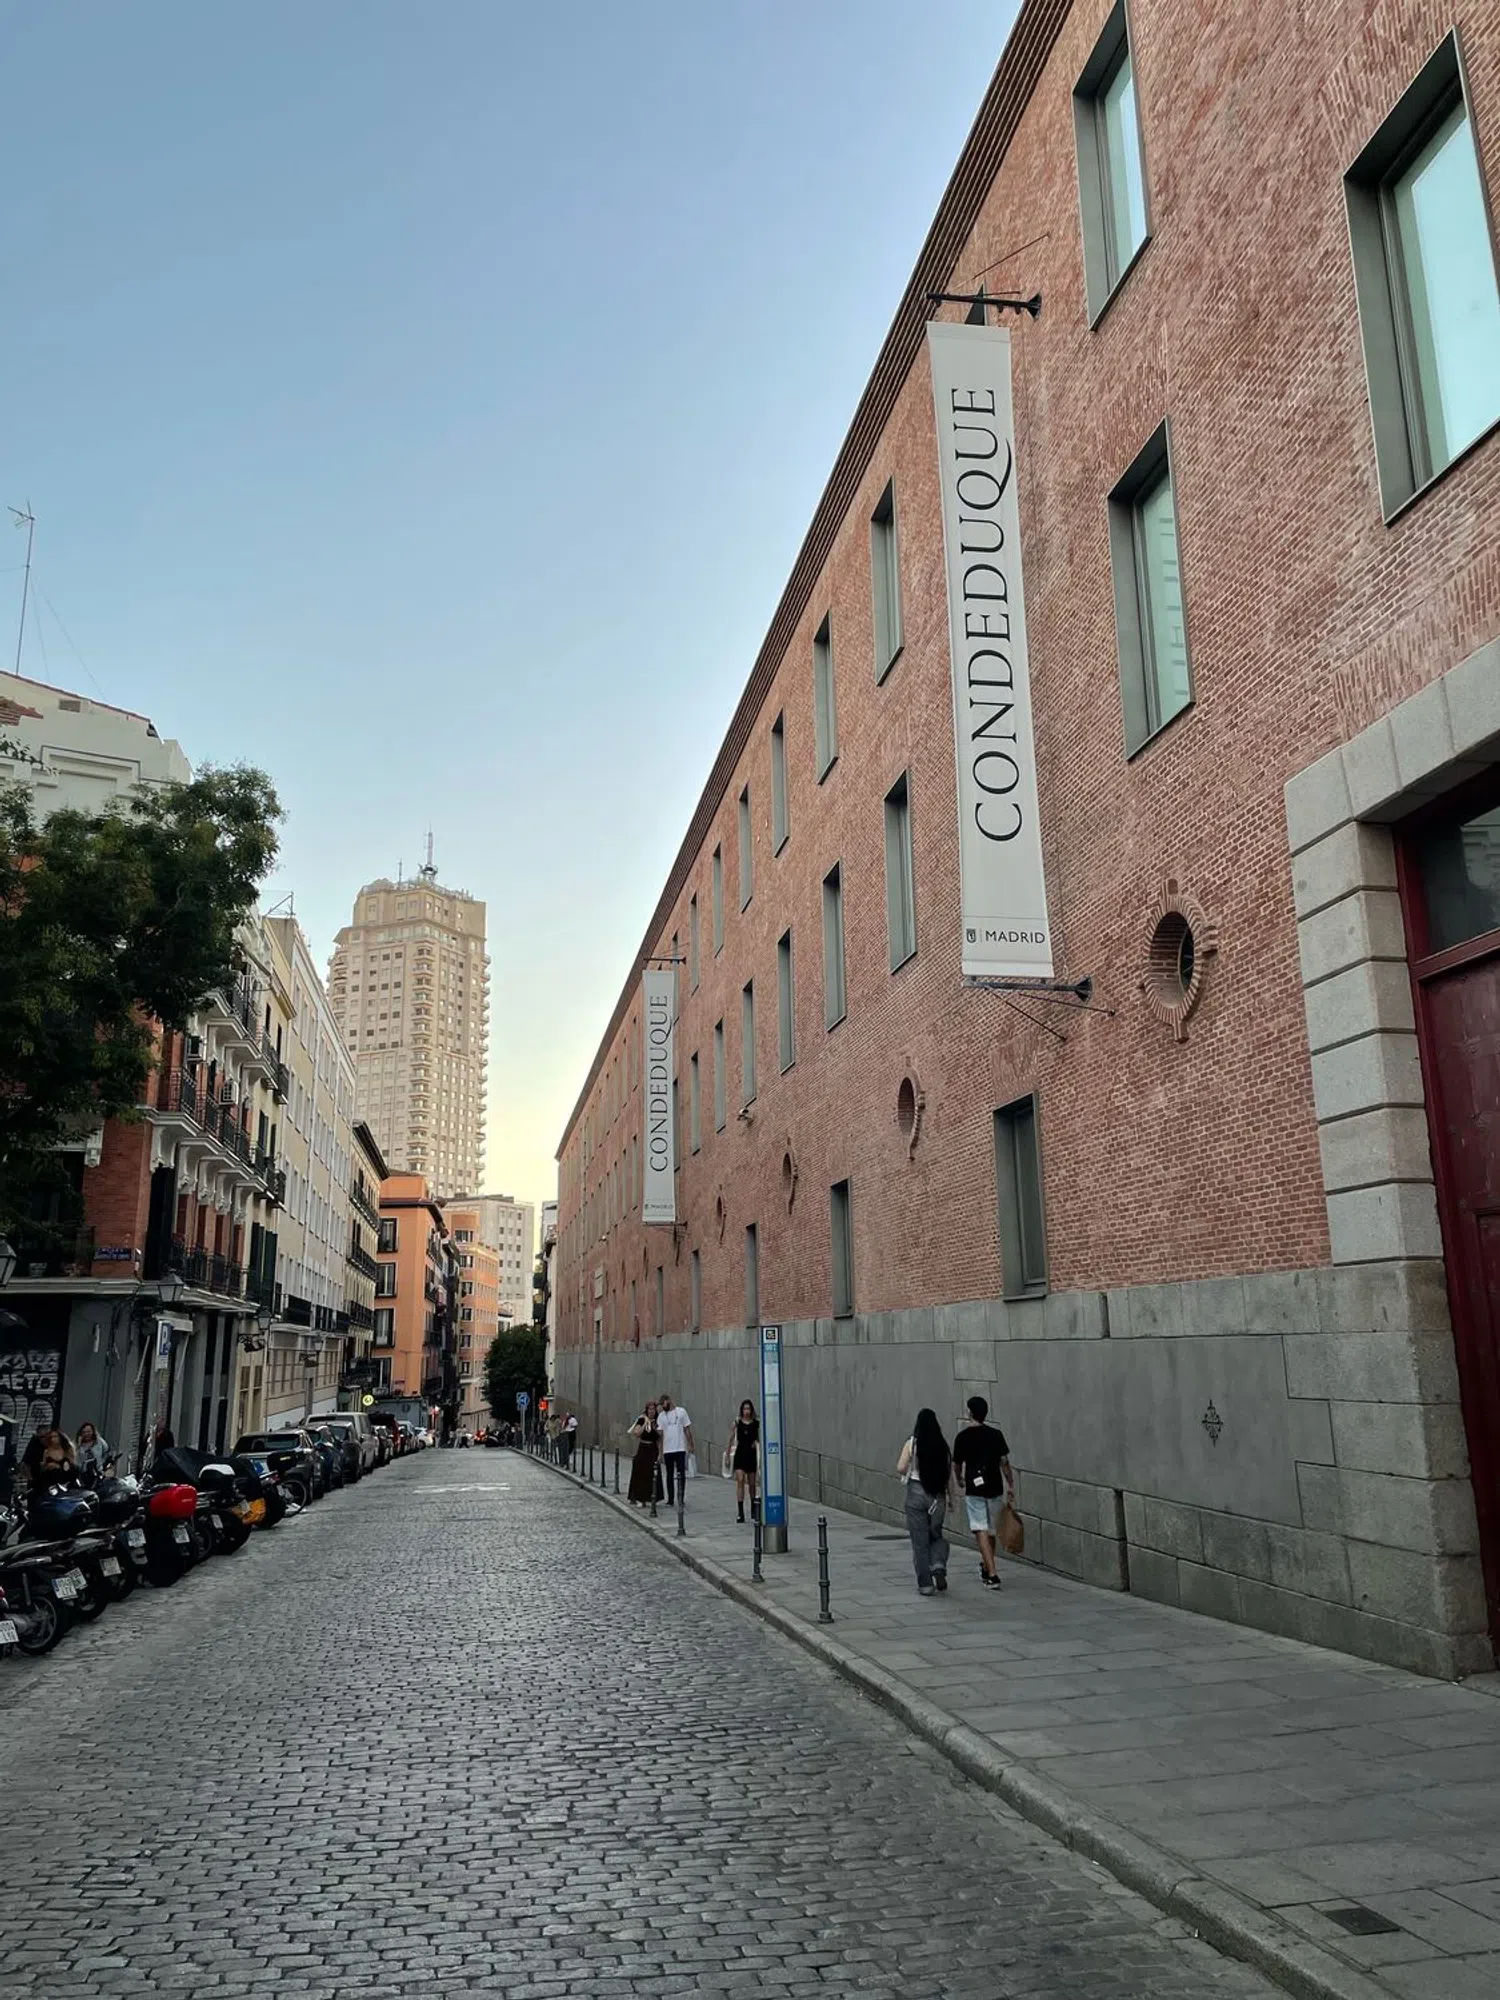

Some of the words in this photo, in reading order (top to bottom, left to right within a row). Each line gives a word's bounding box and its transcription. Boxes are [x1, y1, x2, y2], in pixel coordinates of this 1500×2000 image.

[951, 387, 1022, 842] CONDEDUQUE
[985, 930, 1046, 944] MADRID
[650, 996, 672, 1172] CONDEDUQUE
